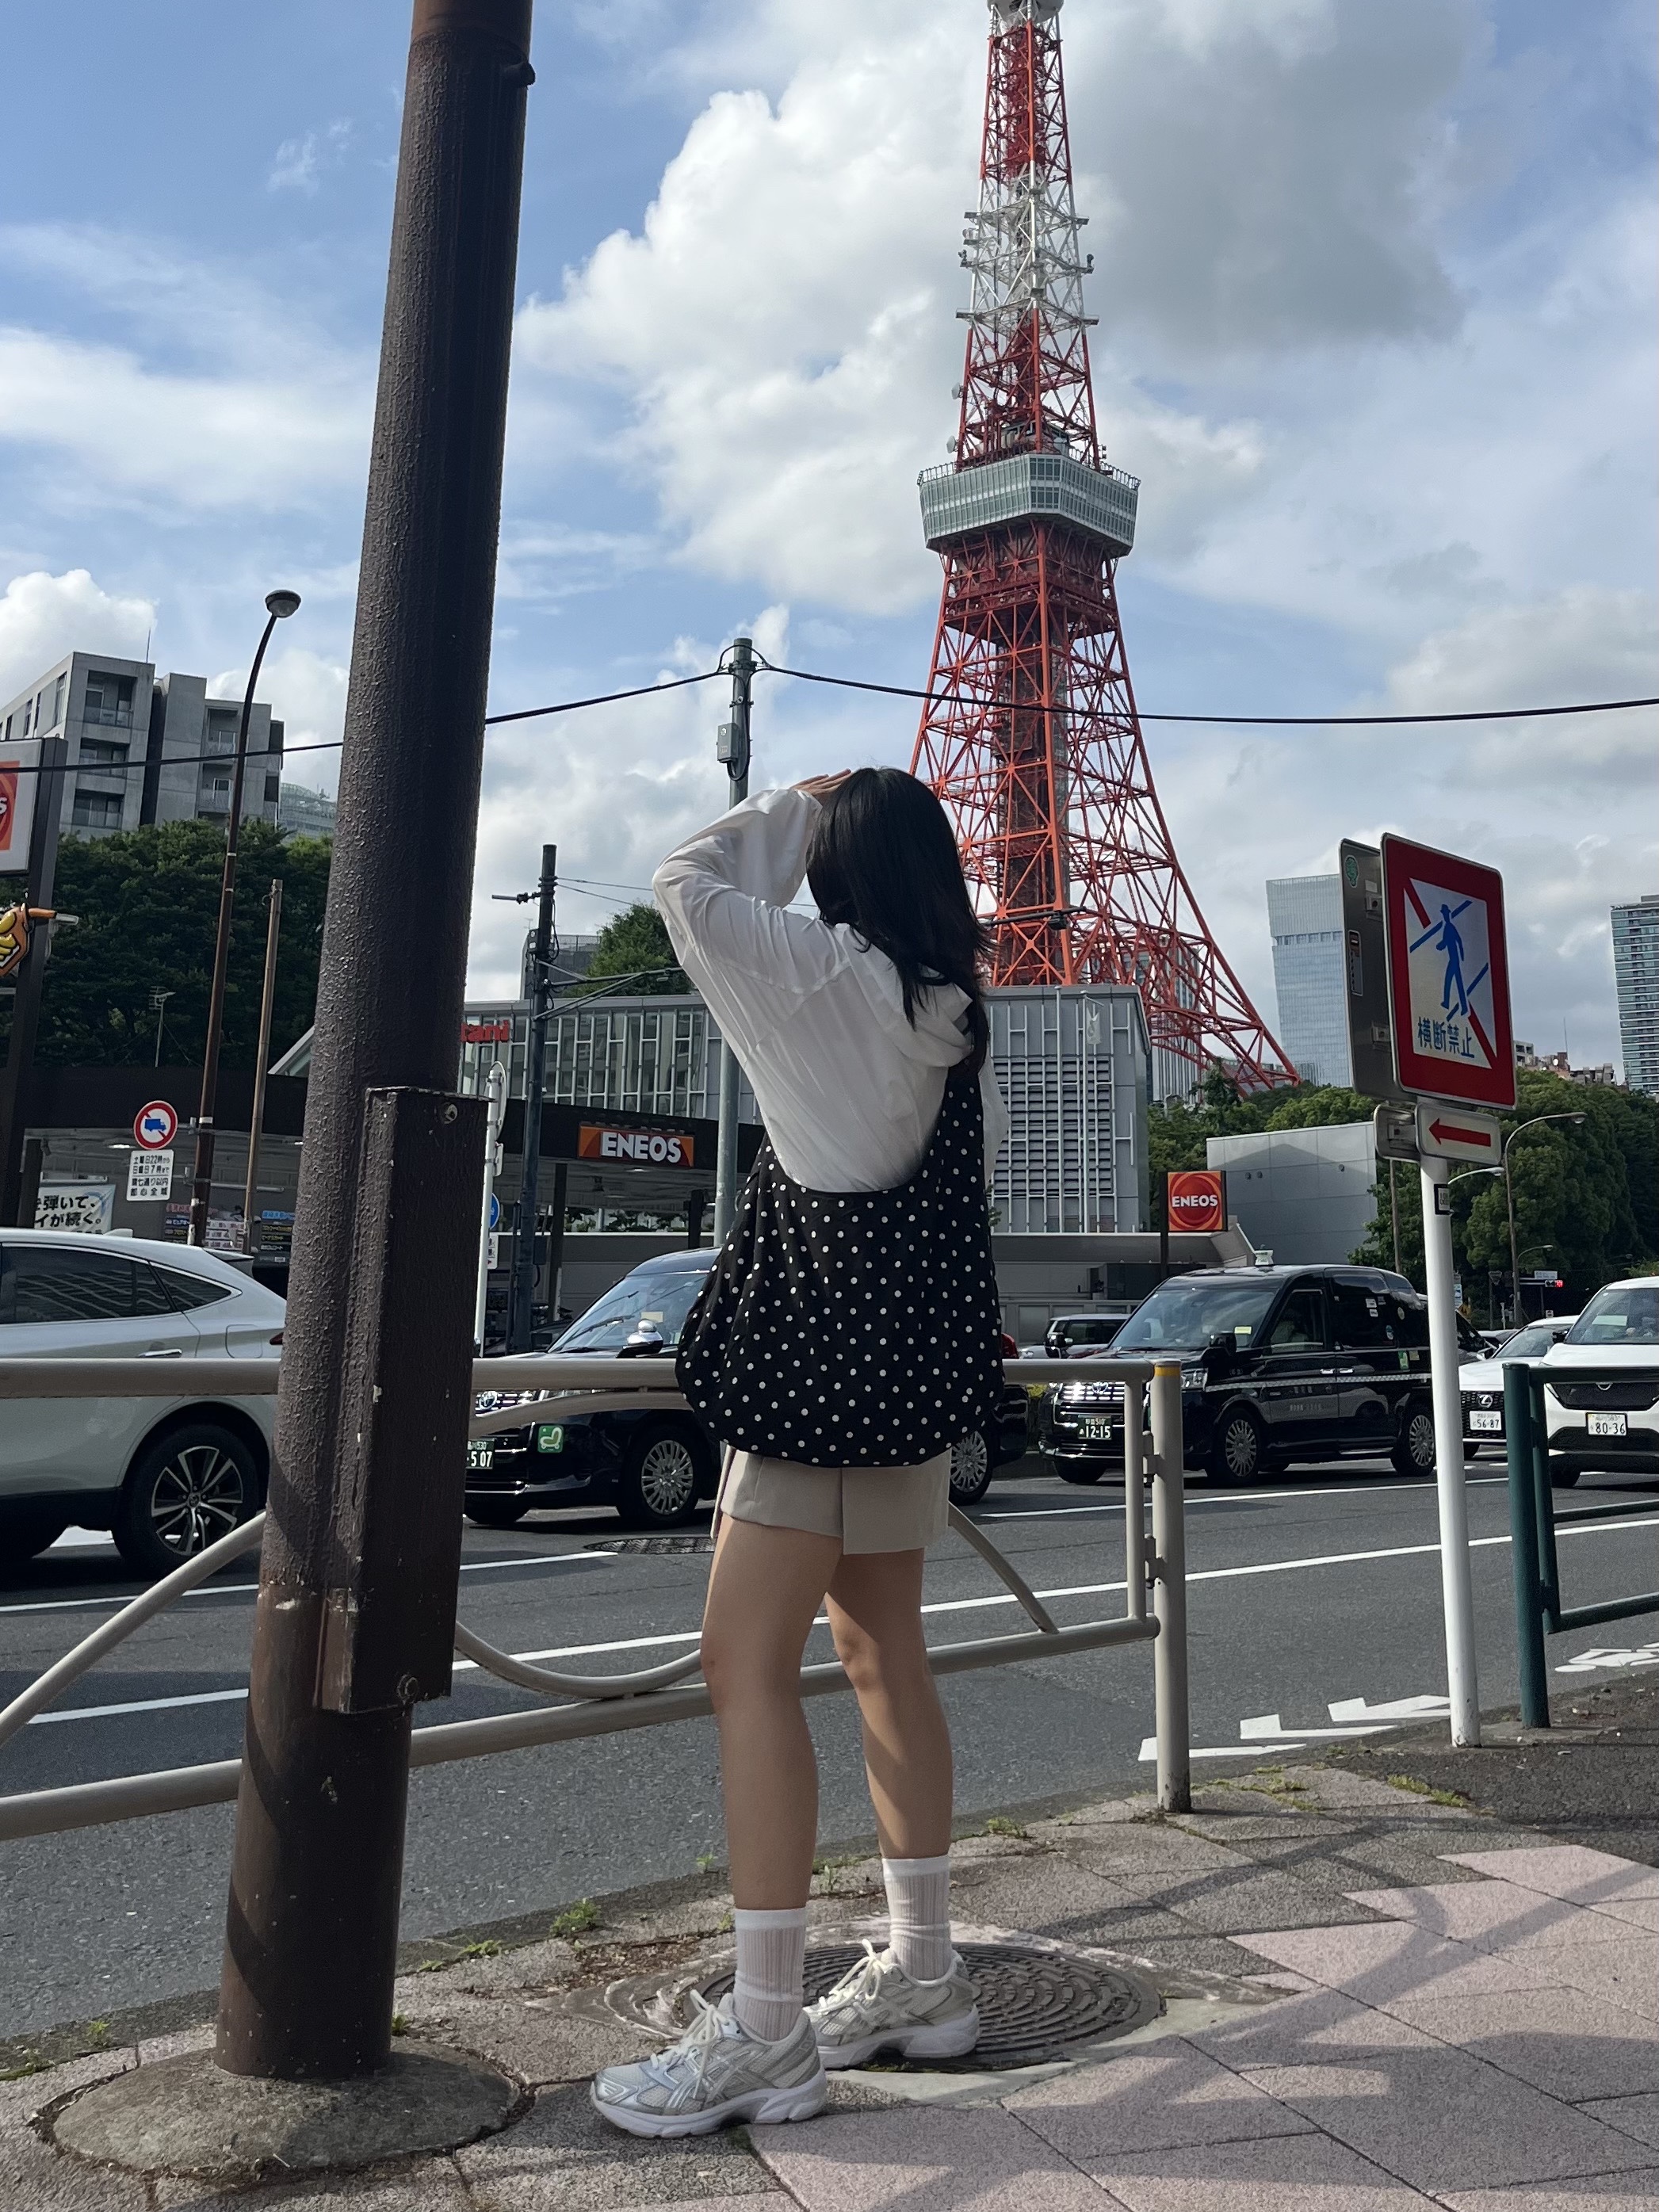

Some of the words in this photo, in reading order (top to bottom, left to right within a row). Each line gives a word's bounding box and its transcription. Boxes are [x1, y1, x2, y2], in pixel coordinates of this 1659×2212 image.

[1417, 1016, 1475, 1058] 横断禁止
[601, 1131, 682, 1163] ENEOS
[1172, 1194, 1218, 1208] ENEOS
